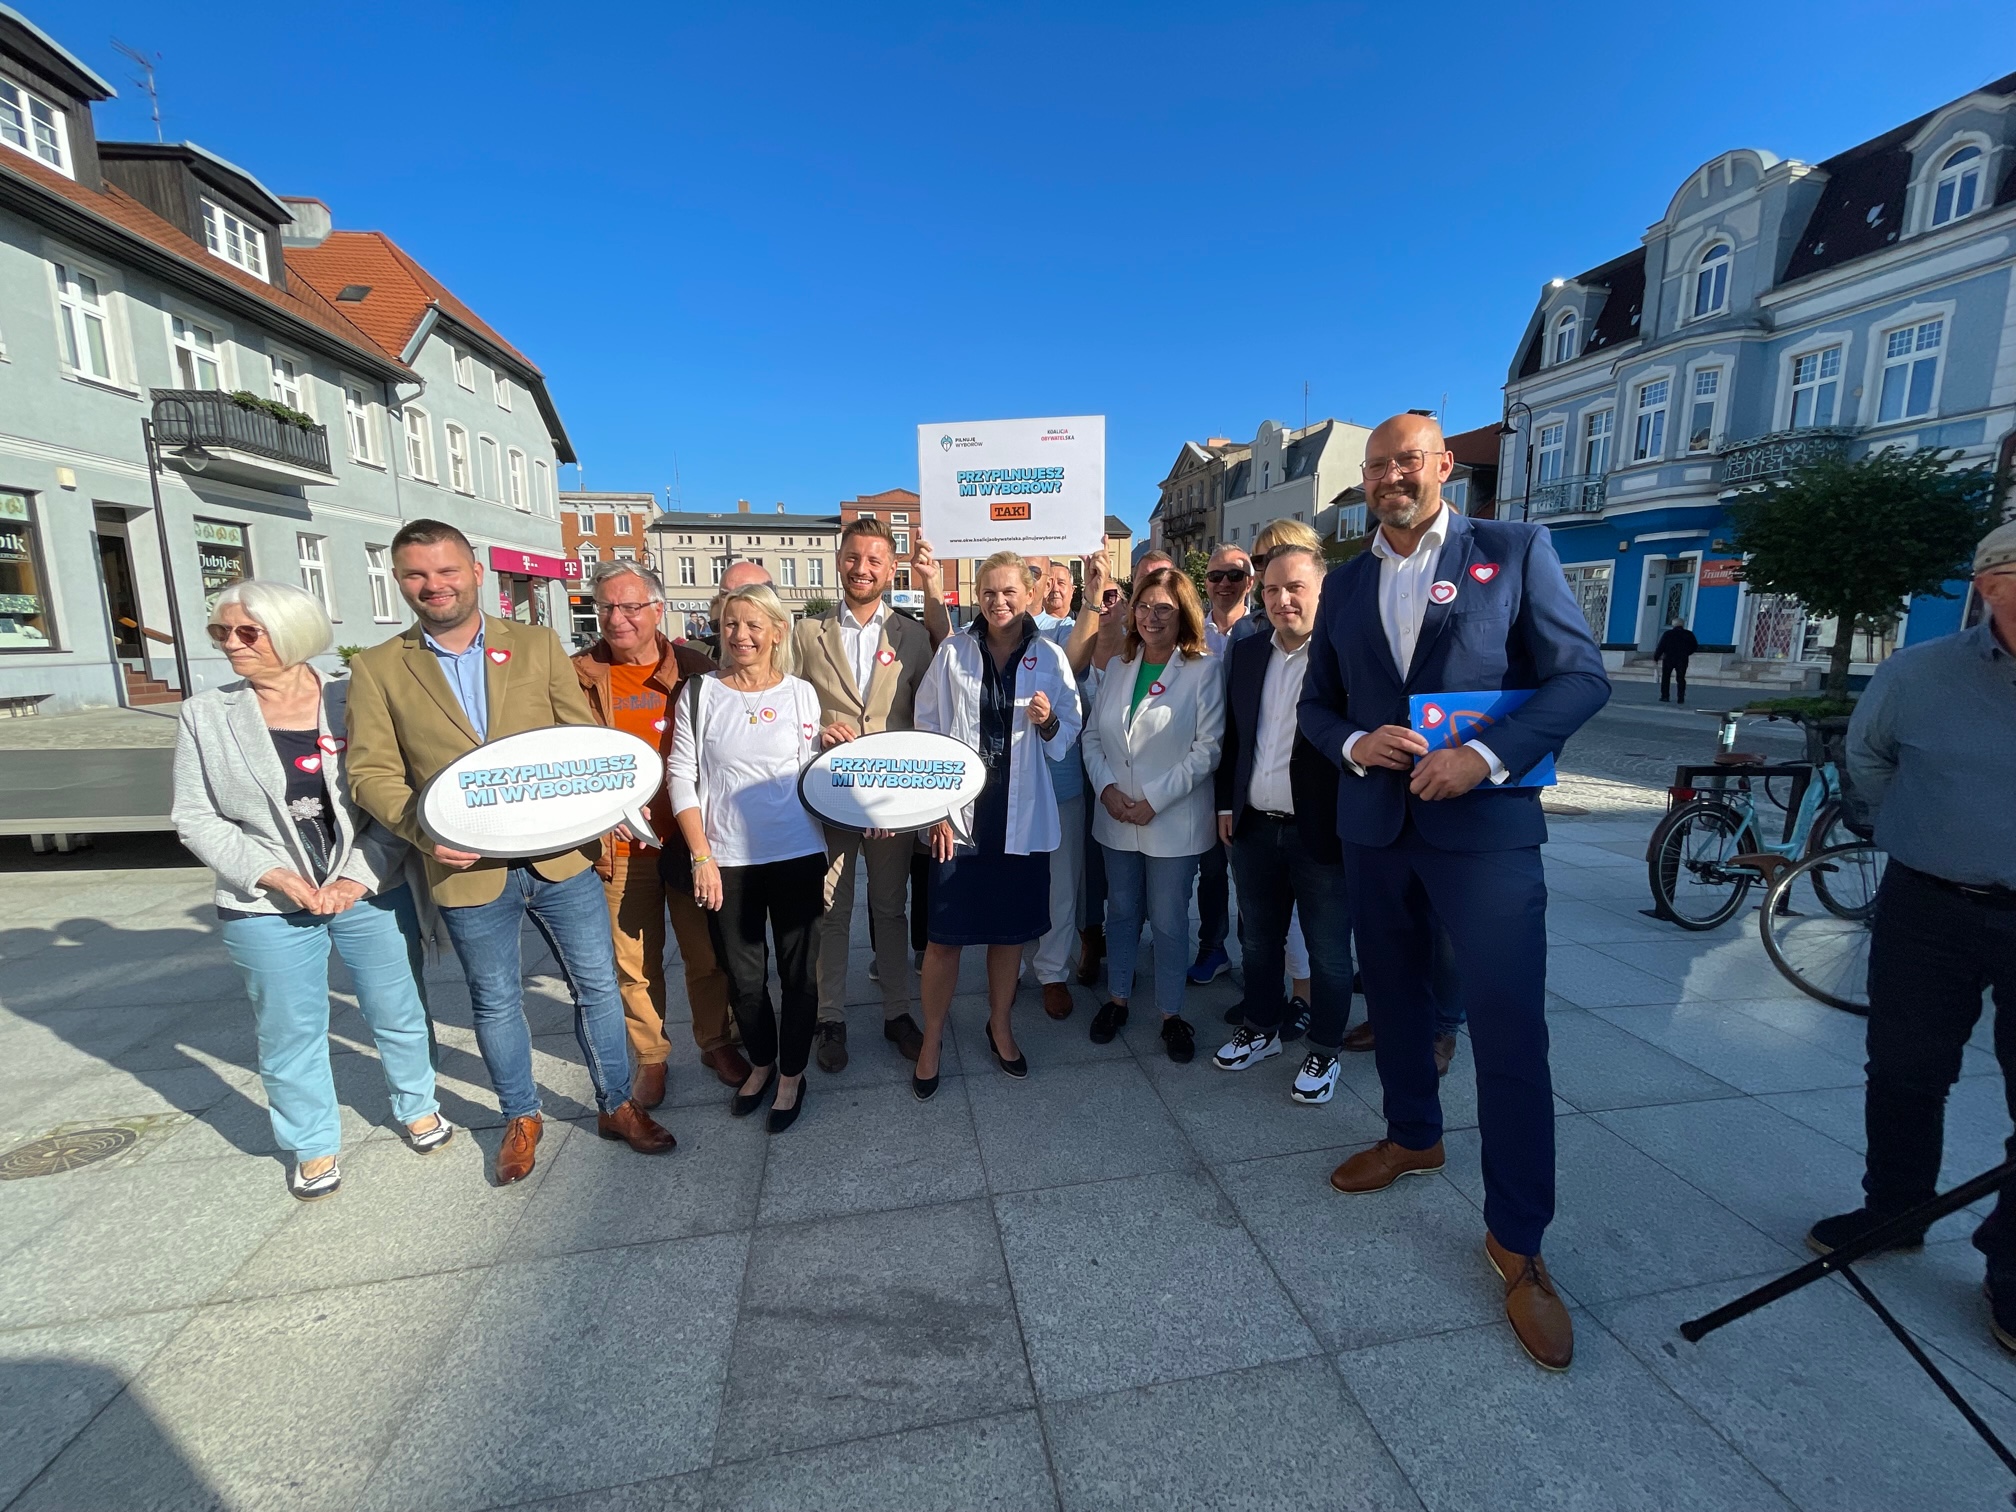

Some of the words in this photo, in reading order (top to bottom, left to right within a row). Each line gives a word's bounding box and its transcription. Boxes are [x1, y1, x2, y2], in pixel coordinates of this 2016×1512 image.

[957, 467, 1064, 483] PRZYPILNUJESZ
[959, 484, 976, 496] MI
[979, 480, 1062, 495] WYBORÓW?
[995, 506, 1025, 517] TAK!
[565, 562, 577, 576] T
[459, 755, 636, 789] PRZYPILNUJESZ
[830, 757, 965, 775] PRZYPILNUJESZ
[832, 774, 854, 788] MI
[857, 773, 962, 790] WYBORÓW?
[465, 788, 498, 808] MI
[500, 772, 635, 803] WYBORÓW?
